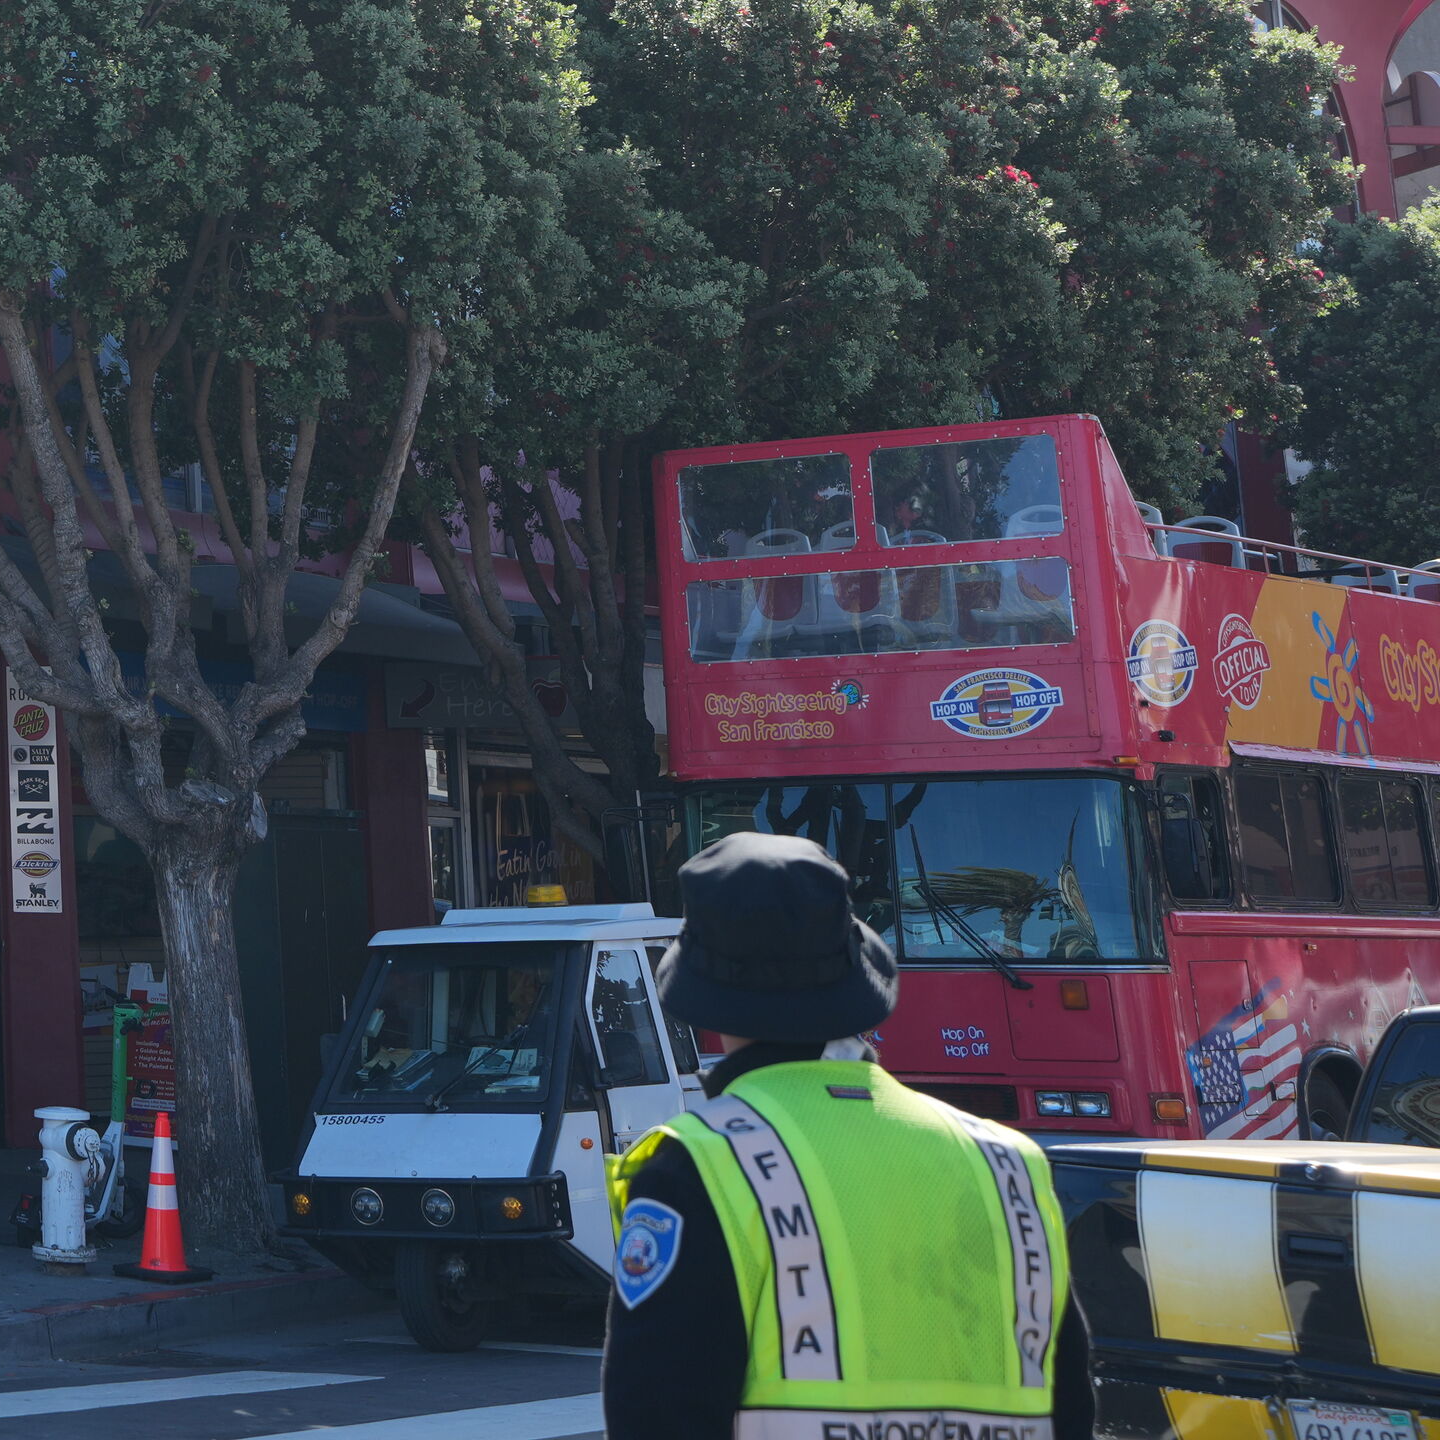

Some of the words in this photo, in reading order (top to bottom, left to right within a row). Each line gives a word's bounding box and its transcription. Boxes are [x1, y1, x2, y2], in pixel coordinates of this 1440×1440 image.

[1219, 646, 1268, 687] OFFICIAL
[953, 682, 967, 694] SAN
[967, 671, 1003, 686] FRANCISCO
[1005, 672, 1031, 685] DELUXE
[1239, 677, 1260, 702] TOUR
[447, 695, 514, 718] Here
[936, 703, 957, 717] HOP
[959, 702, 974, 714] ON
[1015, 694, 1037, 707] HOP
[1039, 691, 1057, 704] OFF
[13, 707, 45, 728] SANTA
[19, 720, 44, 738] CRUZ
[718, 720, 751, 743] San
[753, 718, 835, 741] Francisco
[31, 747, 50, 755] SALTY
[31, 754, 50, 762] CREW
[19, 860, 54, 868] Dickies
[496, 848, 532, 881] Eatin'
[16, 898, 59, 907] STANLEY
[941, 1027, 965, 1041] Hop
[967, 1025, 985, 1039] On
[945, 1044, 969, 1058] Hop
[971, 1042, 989, 1056] Off
[322, 1115, 385, 1126] 15800455
[1315, 1410, 1382, 1424] California
